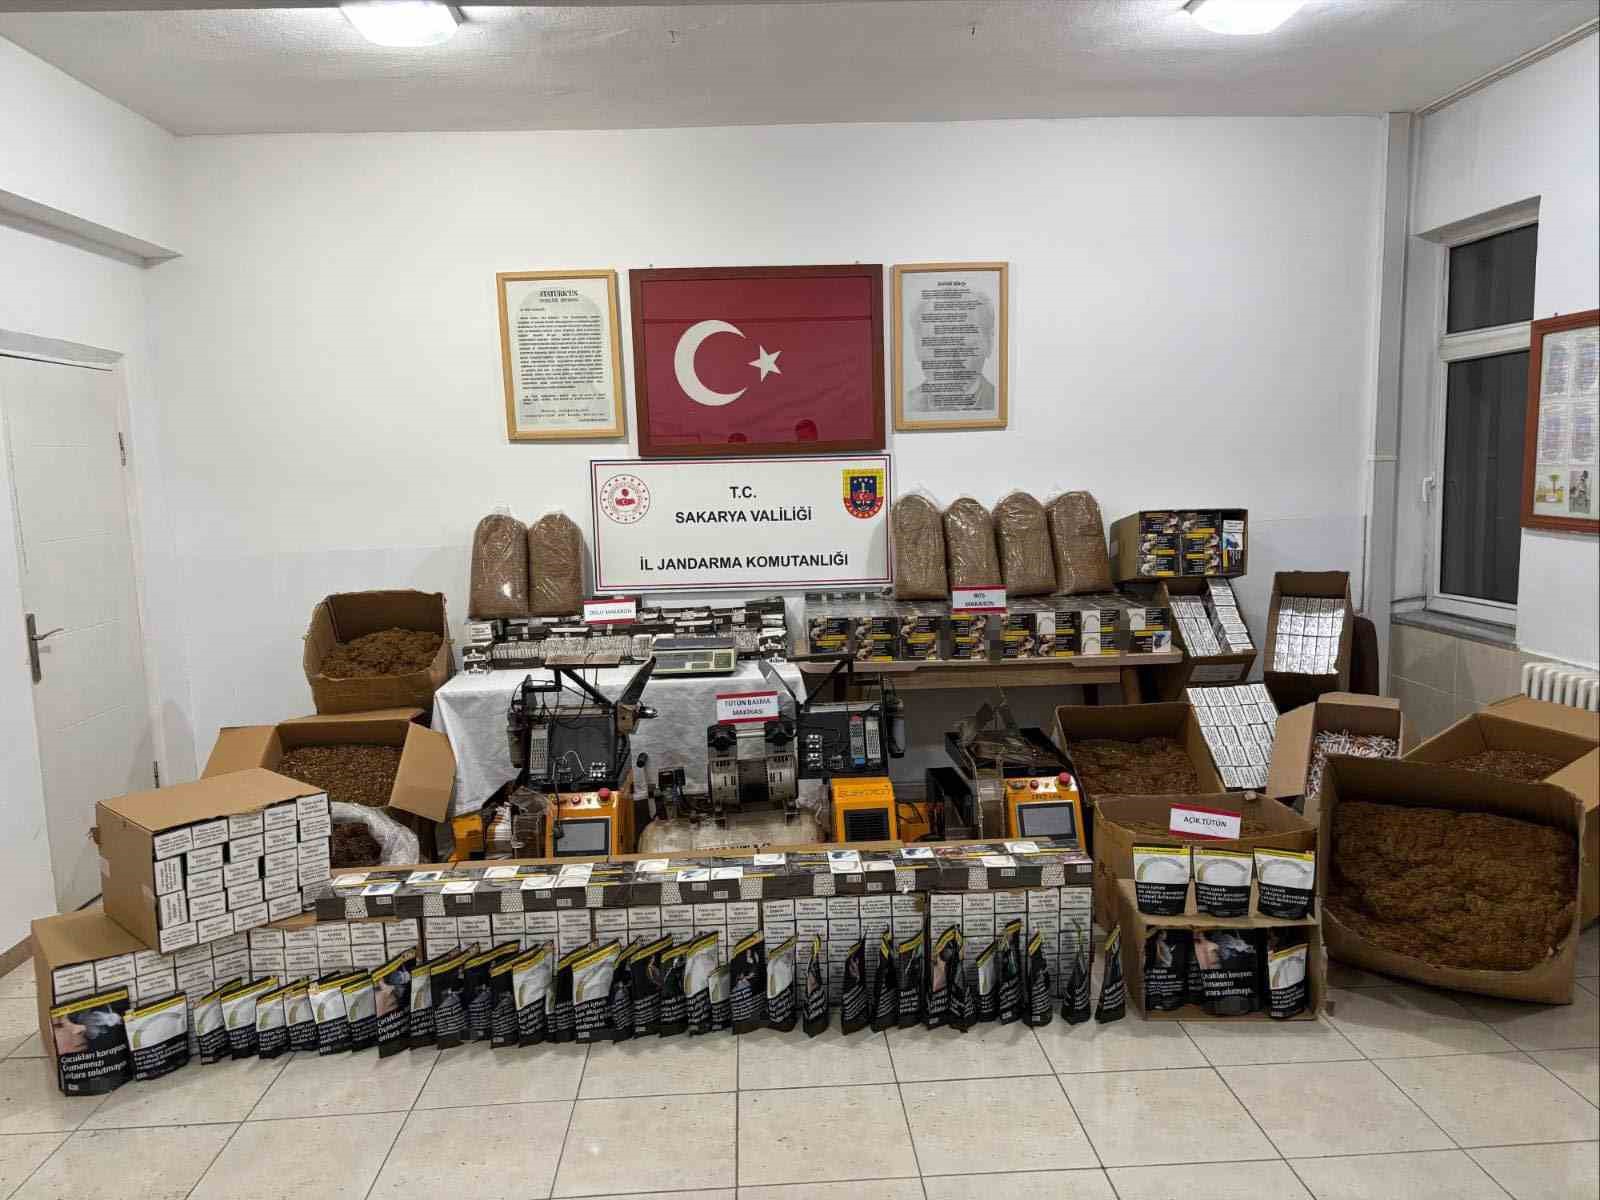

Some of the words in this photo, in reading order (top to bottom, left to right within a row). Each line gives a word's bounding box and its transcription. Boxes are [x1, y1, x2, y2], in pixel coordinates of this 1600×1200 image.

[729, 486, 757, 499] T.C.
[675, 510, 747, 524] SAKARYA
[749, 506, 812, 522] VALİLİĞİ
[640, 556, 653, 571] İL
[657, 556, 742, 570] JANDARMA
[746, 551, 848, 568] KOMUTANLIĞI
[1183, 816, 1200, 825] AÇIK
